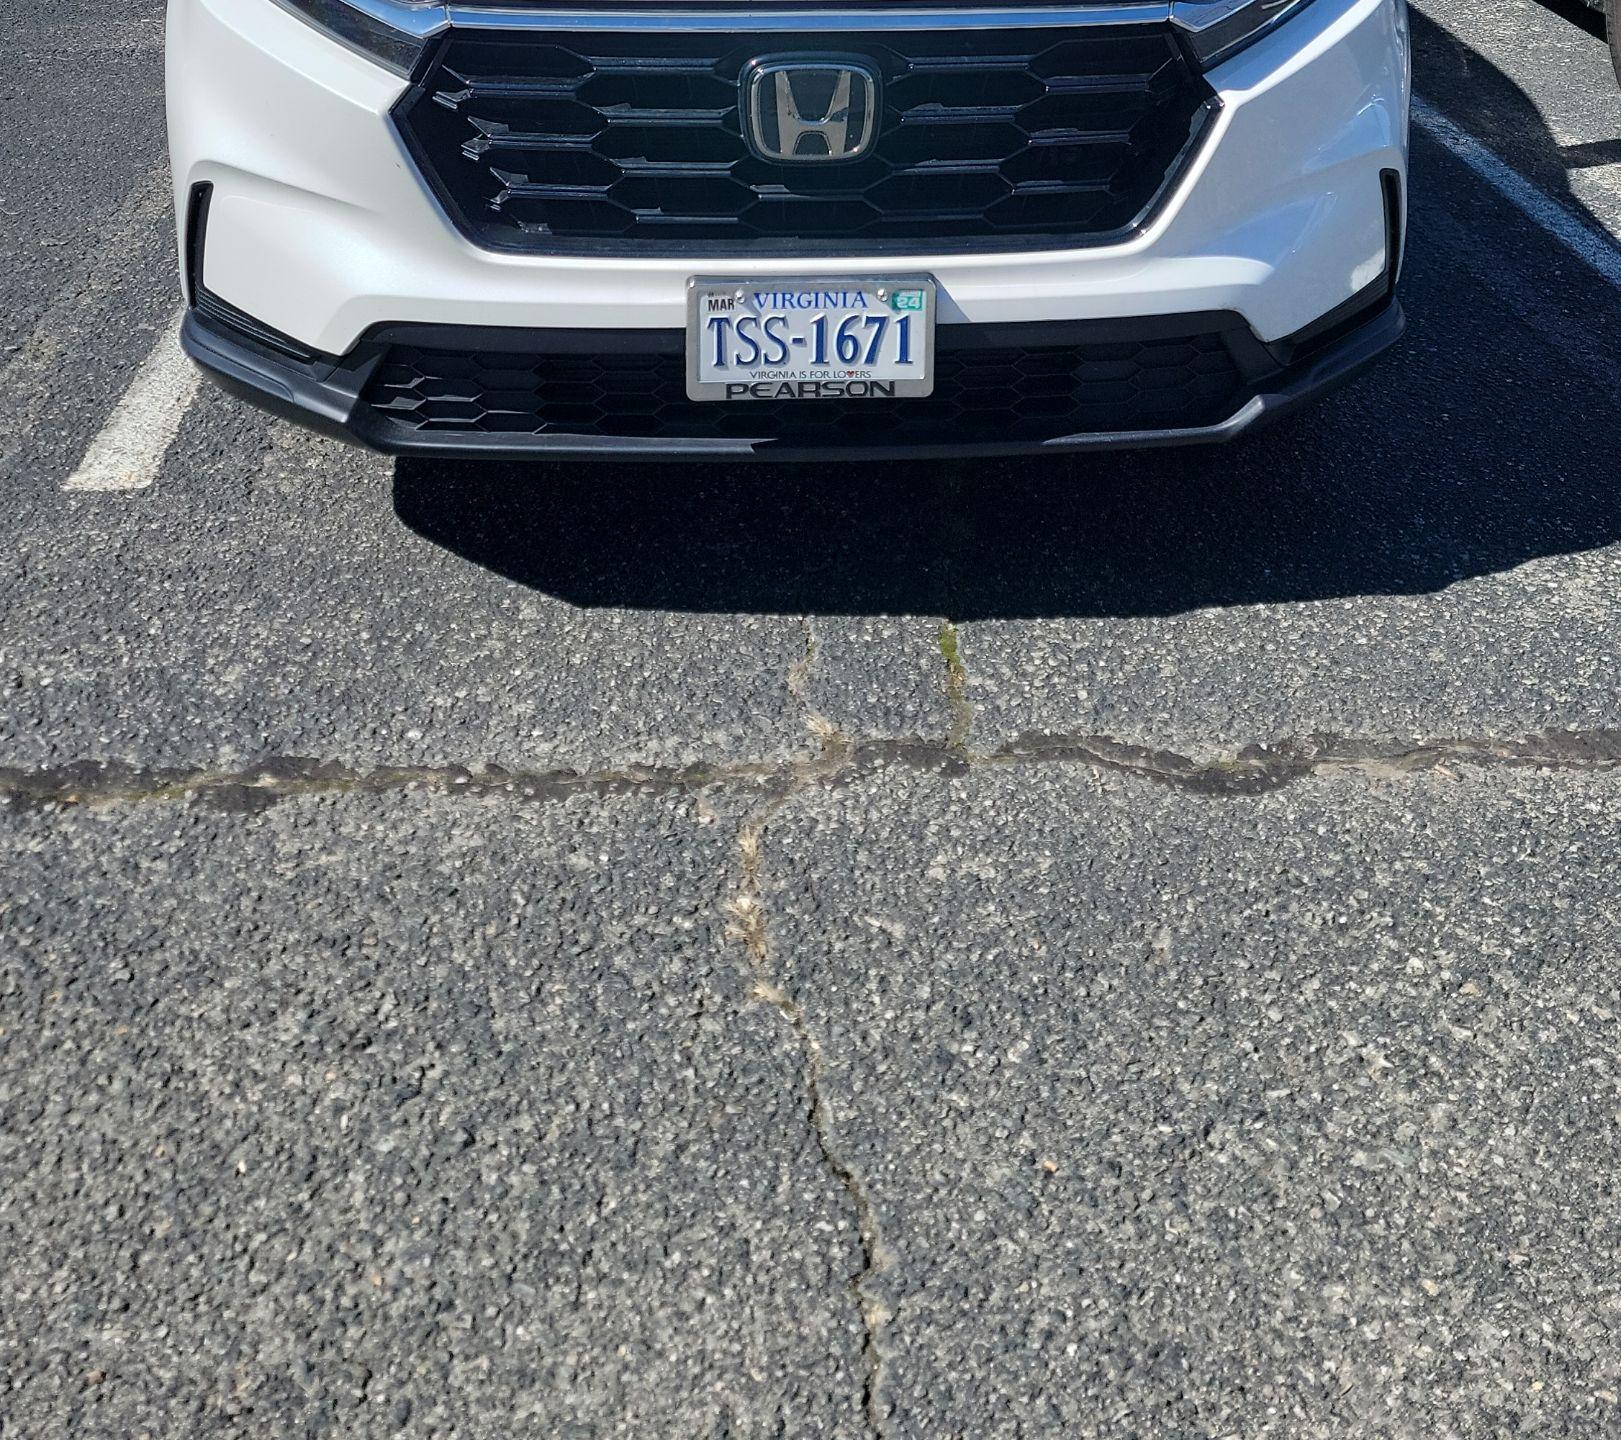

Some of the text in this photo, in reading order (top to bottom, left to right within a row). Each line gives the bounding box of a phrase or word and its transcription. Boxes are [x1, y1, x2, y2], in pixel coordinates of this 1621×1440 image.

[708, 298, 735, 312] MAR
[753, 291, 869, 309] VIRGINIA
[896, 296, 921, 309] 24
[706, 313, 913, 367] TSS-1671
[749, 371, 798, 379] VIRGINIA
[809, 371, 831, 379] FOR
[726, 381, 896, 399] PEARSON
